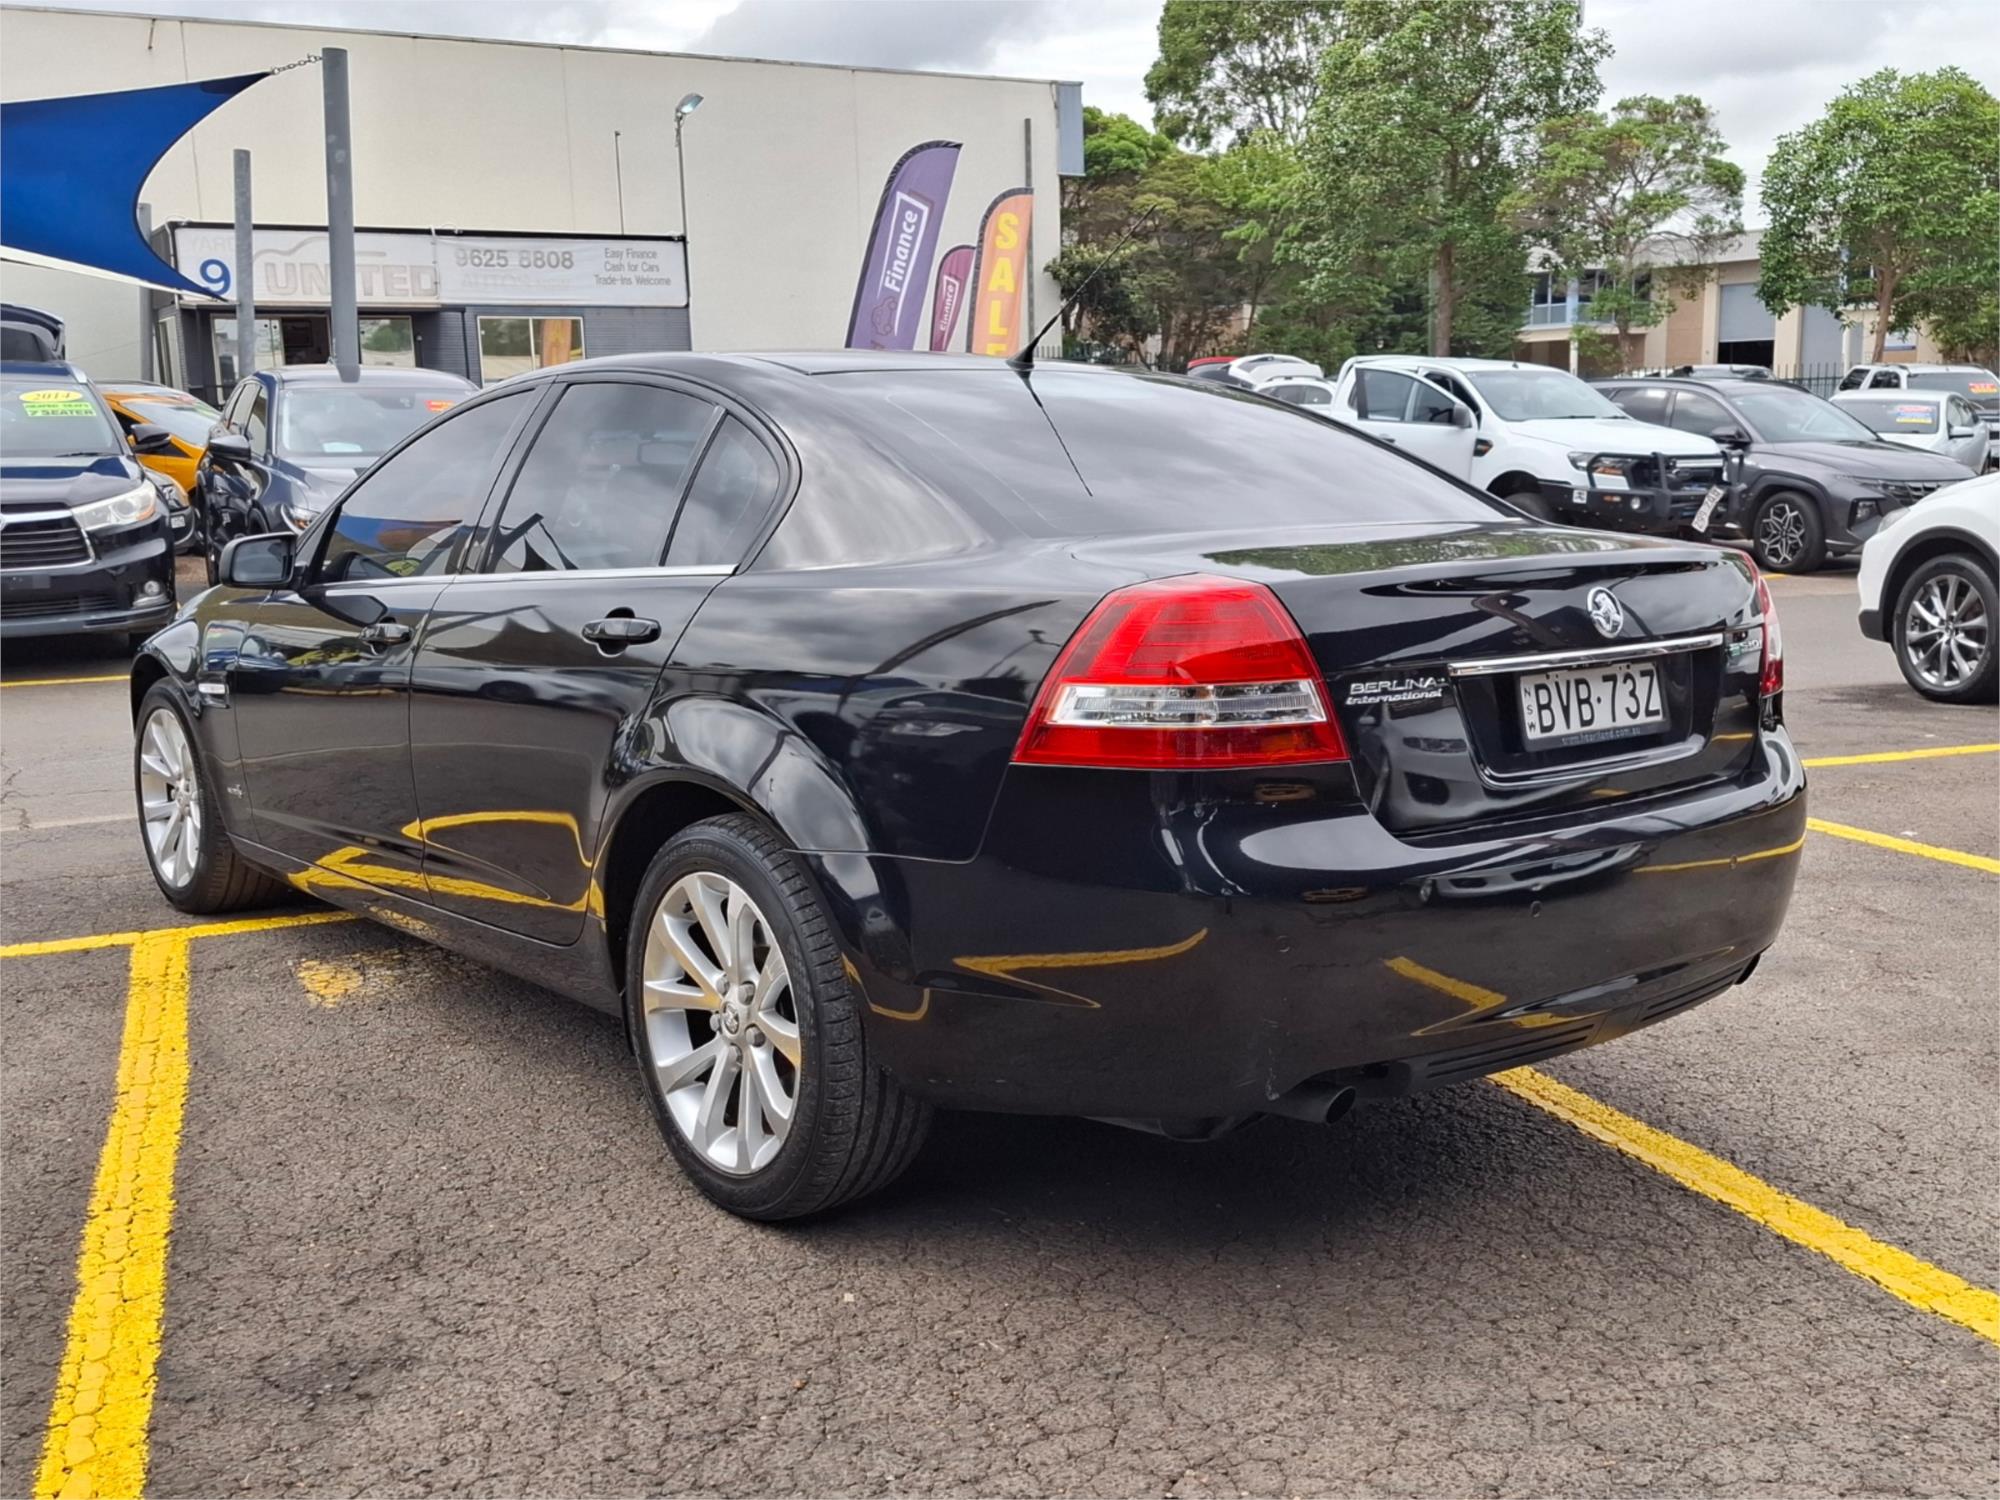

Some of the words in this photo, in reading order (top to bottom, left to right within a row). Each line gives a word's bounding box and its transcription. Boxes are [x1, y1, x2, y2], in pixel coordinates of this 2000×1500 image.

[455, 248, 509, 268] 9625
[519, 250, 575, 269] 8808
[604, 247, 624, 261] Easy
[626, 247, 658, 260] Finance
[884, 209, 918, 293] Finance
[604, 260, 625, 272] Cash
[627, 261, 639, 272] for
[641, 261, 660, 273] Cars
[200, 258, 231, 296] 9
[264, 261, 438, 297] UNTED
[594, 274, 633, 286] Trade-Ins
[636, 275, 671, 286] Welcome
[938, 283, 955, 333] Finance
[1349, 677, 1438, 695] BERLINA
[1345, 688, 1443, 705] International
